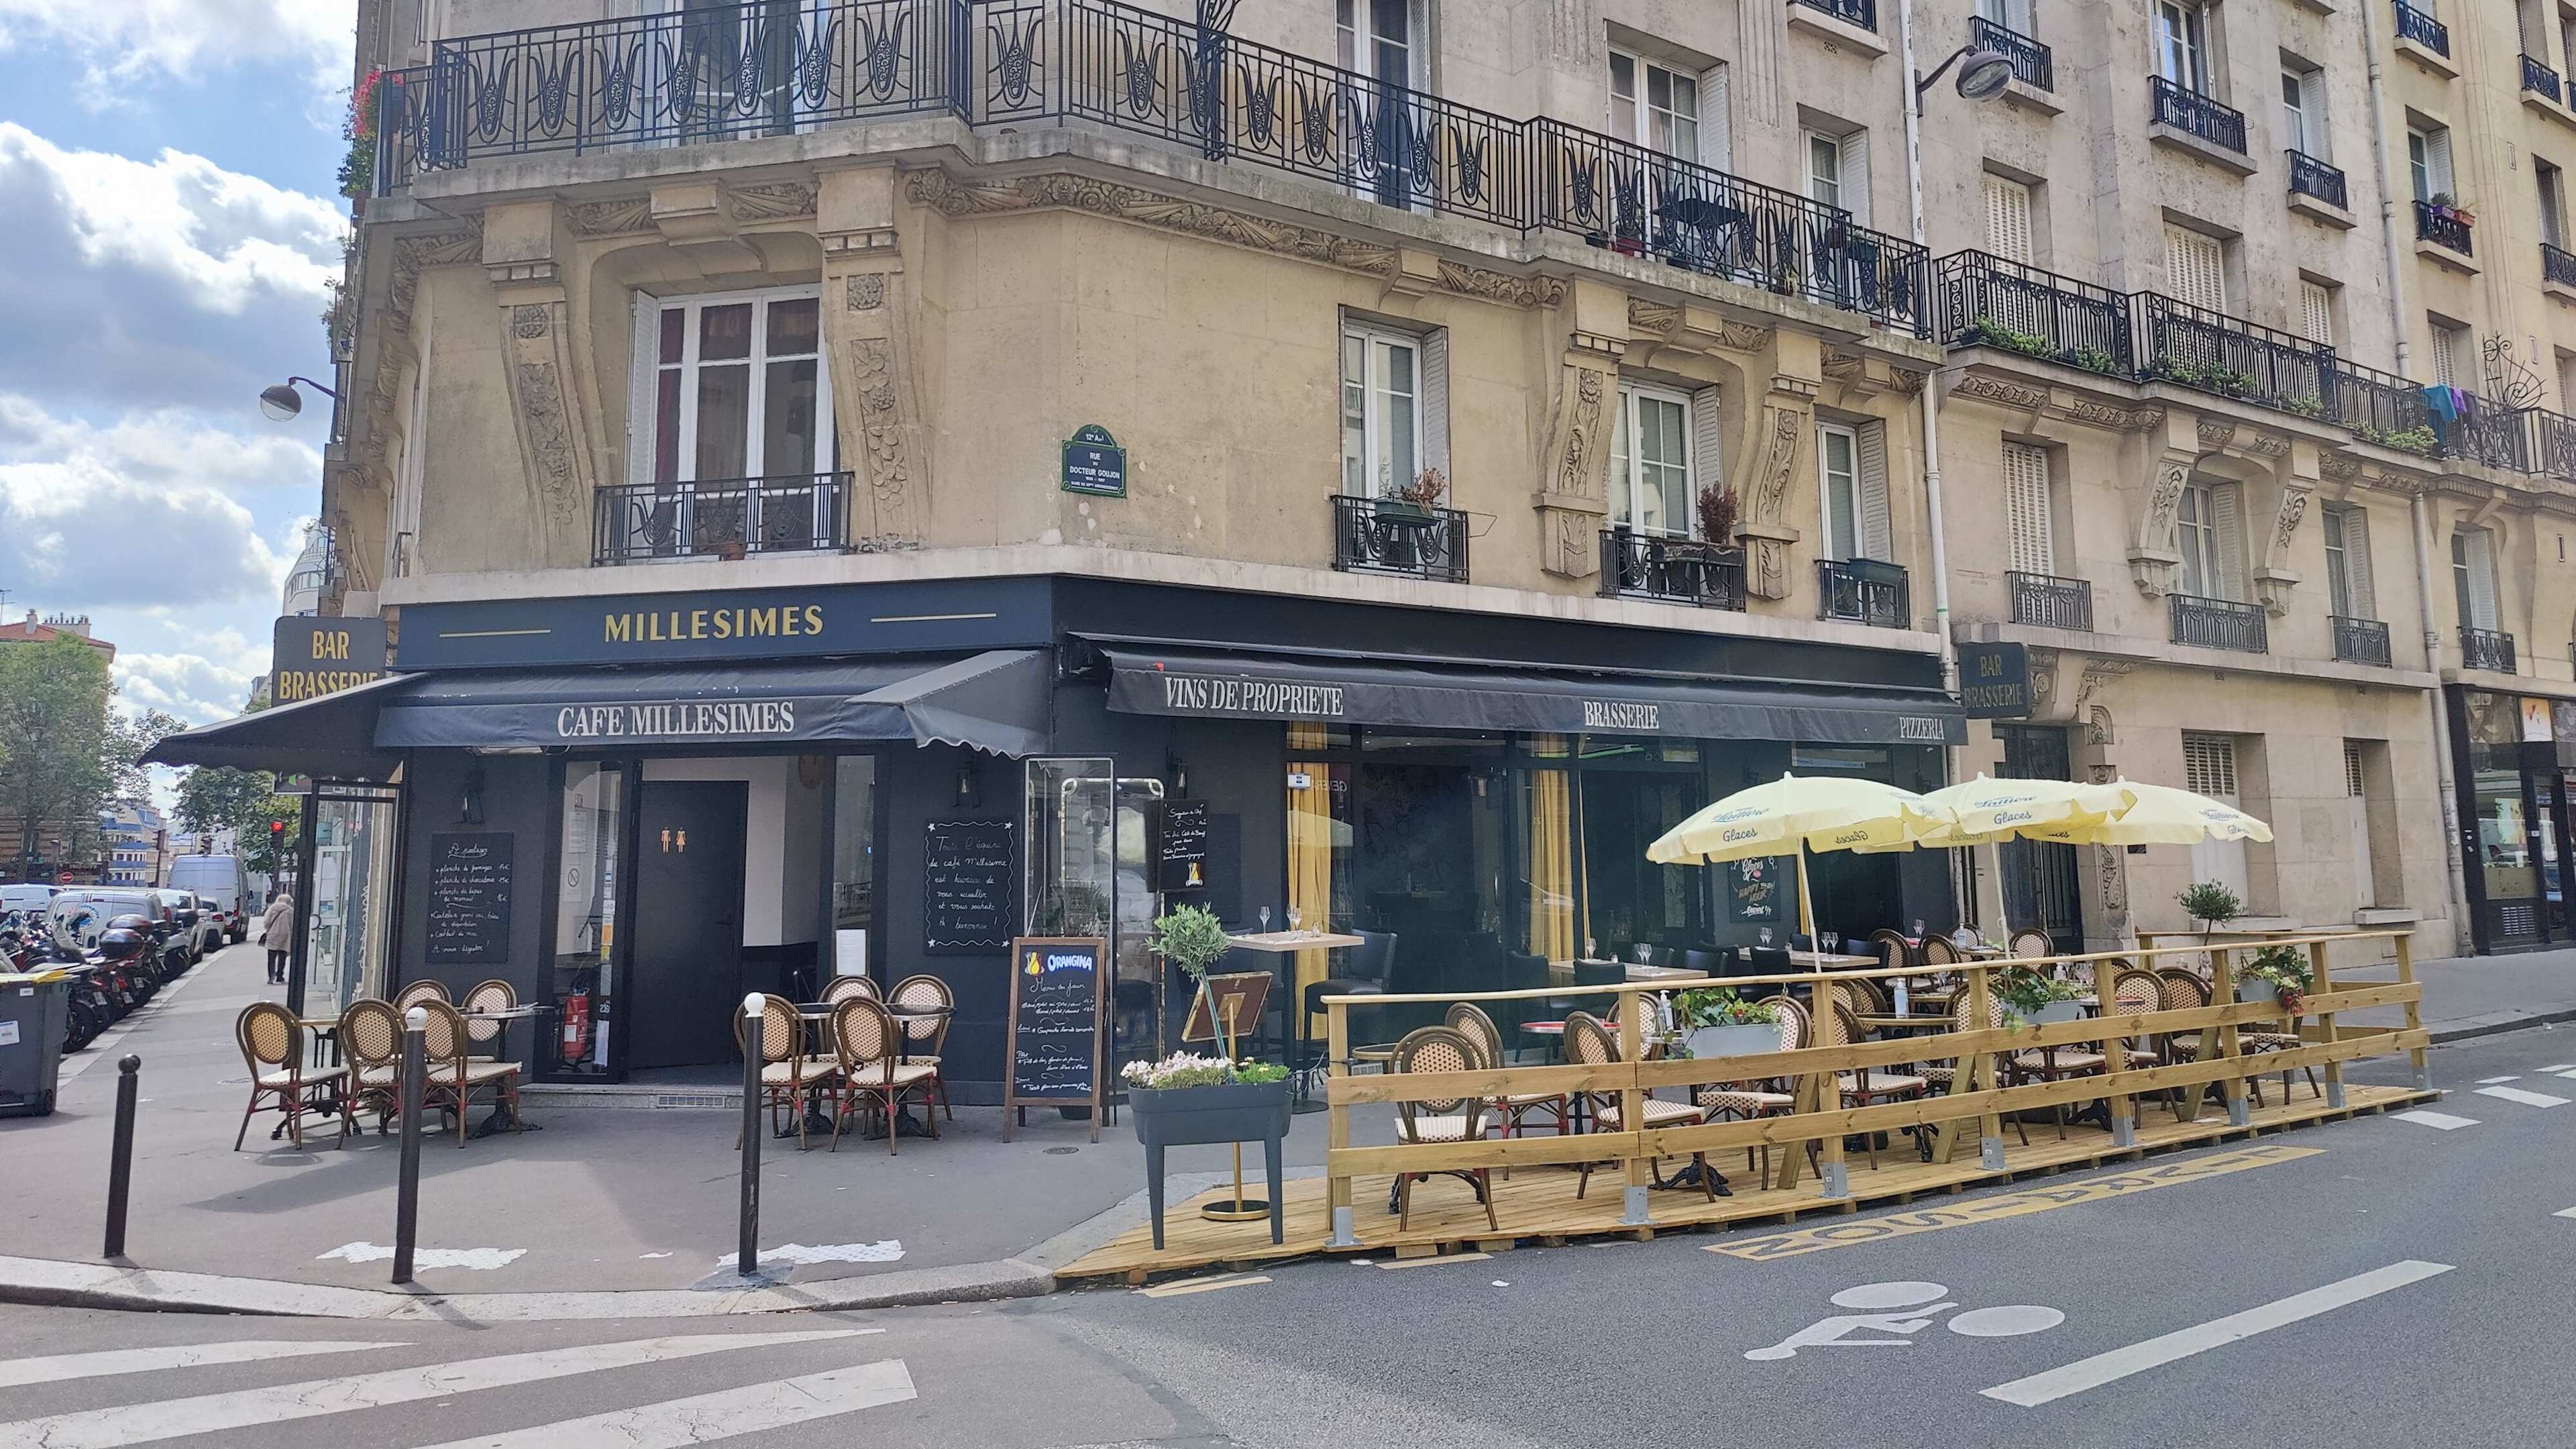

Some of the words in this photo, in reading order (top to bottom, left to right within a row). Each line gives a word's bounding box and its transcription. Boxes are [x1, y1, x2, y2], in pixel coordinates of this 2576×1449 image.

[1089, 452, 1101, 460] RUE
[1069, 466, 1096, 476] DOCTEUR
[1097, 470, 1120, 479] GOUJON
[605, 605, 823, 642] MILLESIMES
[312, 631, 349, 659] BAR
[1980, 655, 2002, 677] BAR
[1165, 677, 1208, 709] VINS
[1211, 680, 1239, 710] DE
[1242, 682, 1343, 716] PROPRIETE
[1964, 683, 2023, 709] BRASSERIE
[557, 706, 624, 737] CAFE
[631, 701, 794, 736] MILLESIMES
[1583, 701, 1659, 729] BRASSERIE
[1899, 716, 1945, 740] PIZZERIA
[1994, 810, 2033, 824] Glaces
[1723, 828, 1758, 843] Glaces
[930, 857, 938, 867] du
[943, 855, 961, 869] café
[934, 873, 947, 883] est
[986, 875, 994, 884] de
[1739, 883, 1759, 900] HAPPY
[1749, 890, 1767, 903] HOUR
[938, 901, 946, 910] et
[1030, 976, 1055, 993] Menu
[1058, 982, 1066, 990] du
[1066, 979, 1085, 997] jour
[1717, 1147, 2284, 1256] LIVRAISON
